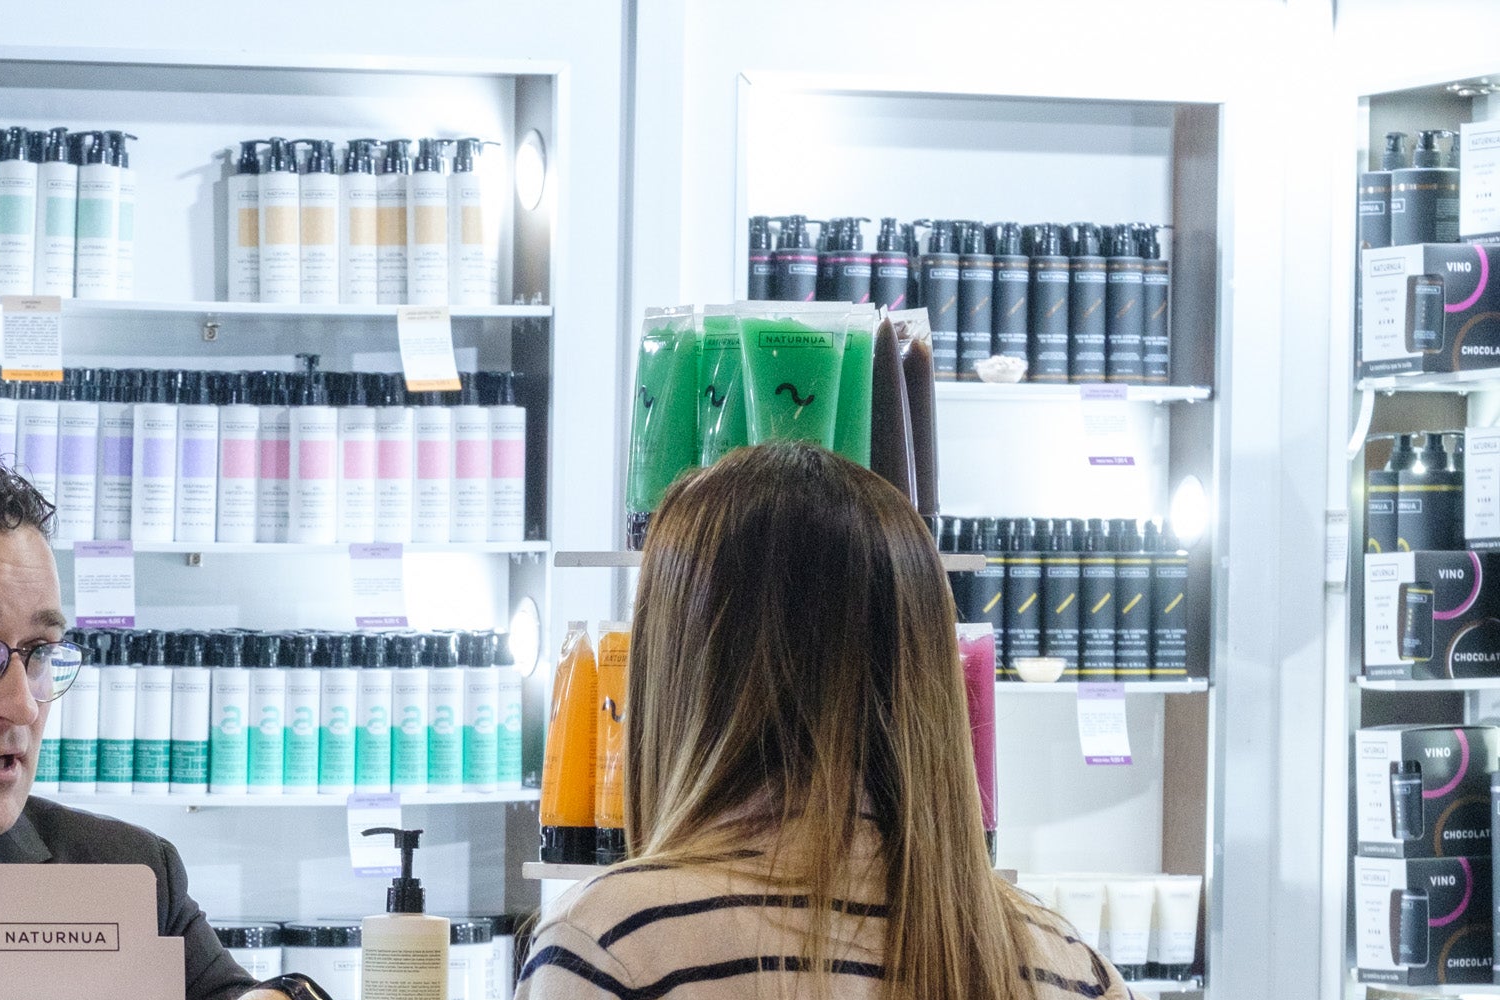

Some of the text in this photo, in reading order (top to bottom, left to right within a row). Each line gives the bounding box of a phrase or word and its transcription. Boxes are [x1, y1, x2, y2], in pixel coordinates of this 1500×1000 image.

[1446, 262, 1472, 272] VINO
[765, 334, 826, 344] NATURNUA
[1438, 569, 1464, 579] VINO
[1424, 747, 1451, 758] VINO
[1430, 876, 1456, 886] VINO
[5, 930, 106, 944] NATURNUA
